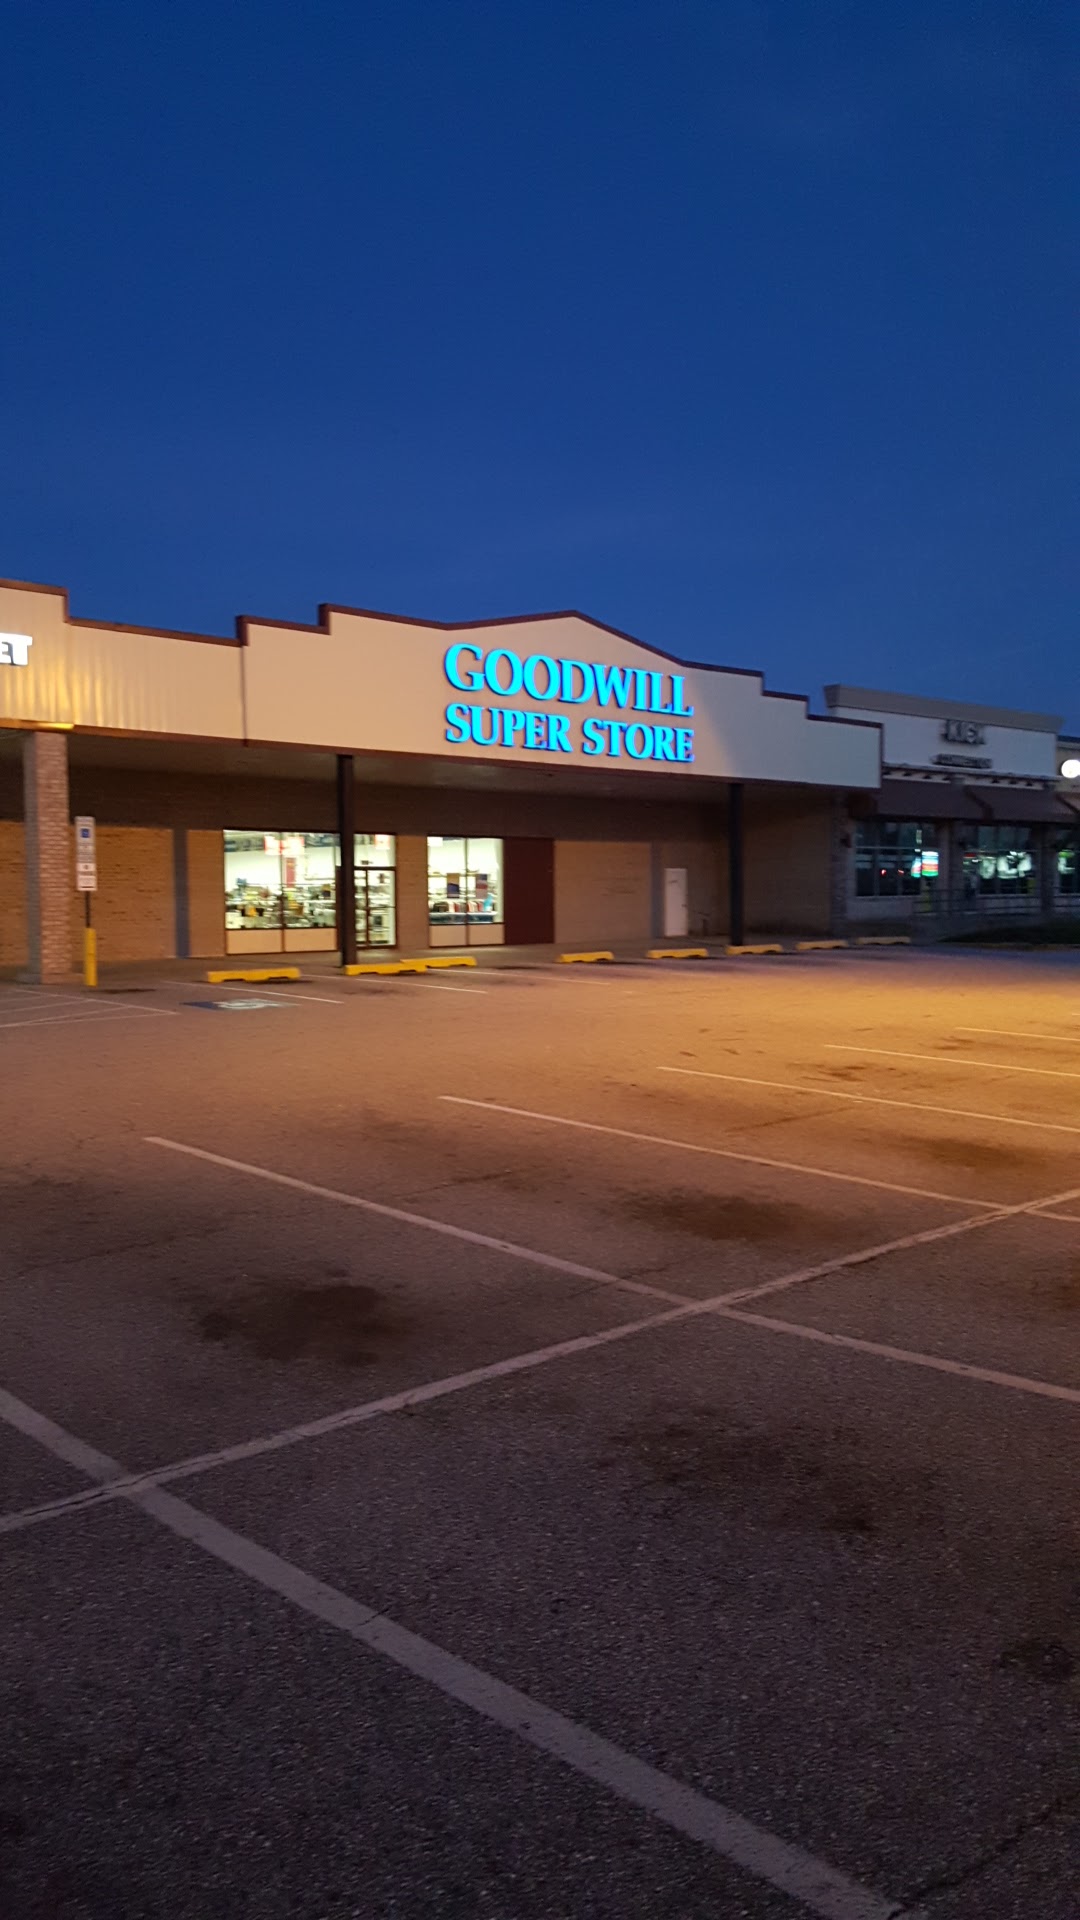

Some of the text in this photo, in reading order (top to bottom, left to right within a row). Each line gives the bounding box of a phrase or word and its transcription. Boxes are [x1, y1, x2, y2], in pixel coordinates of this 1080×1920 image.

[444, 642, 694, 717] GOODWILL
[445, 703, 694, 763] SUPER STORE
